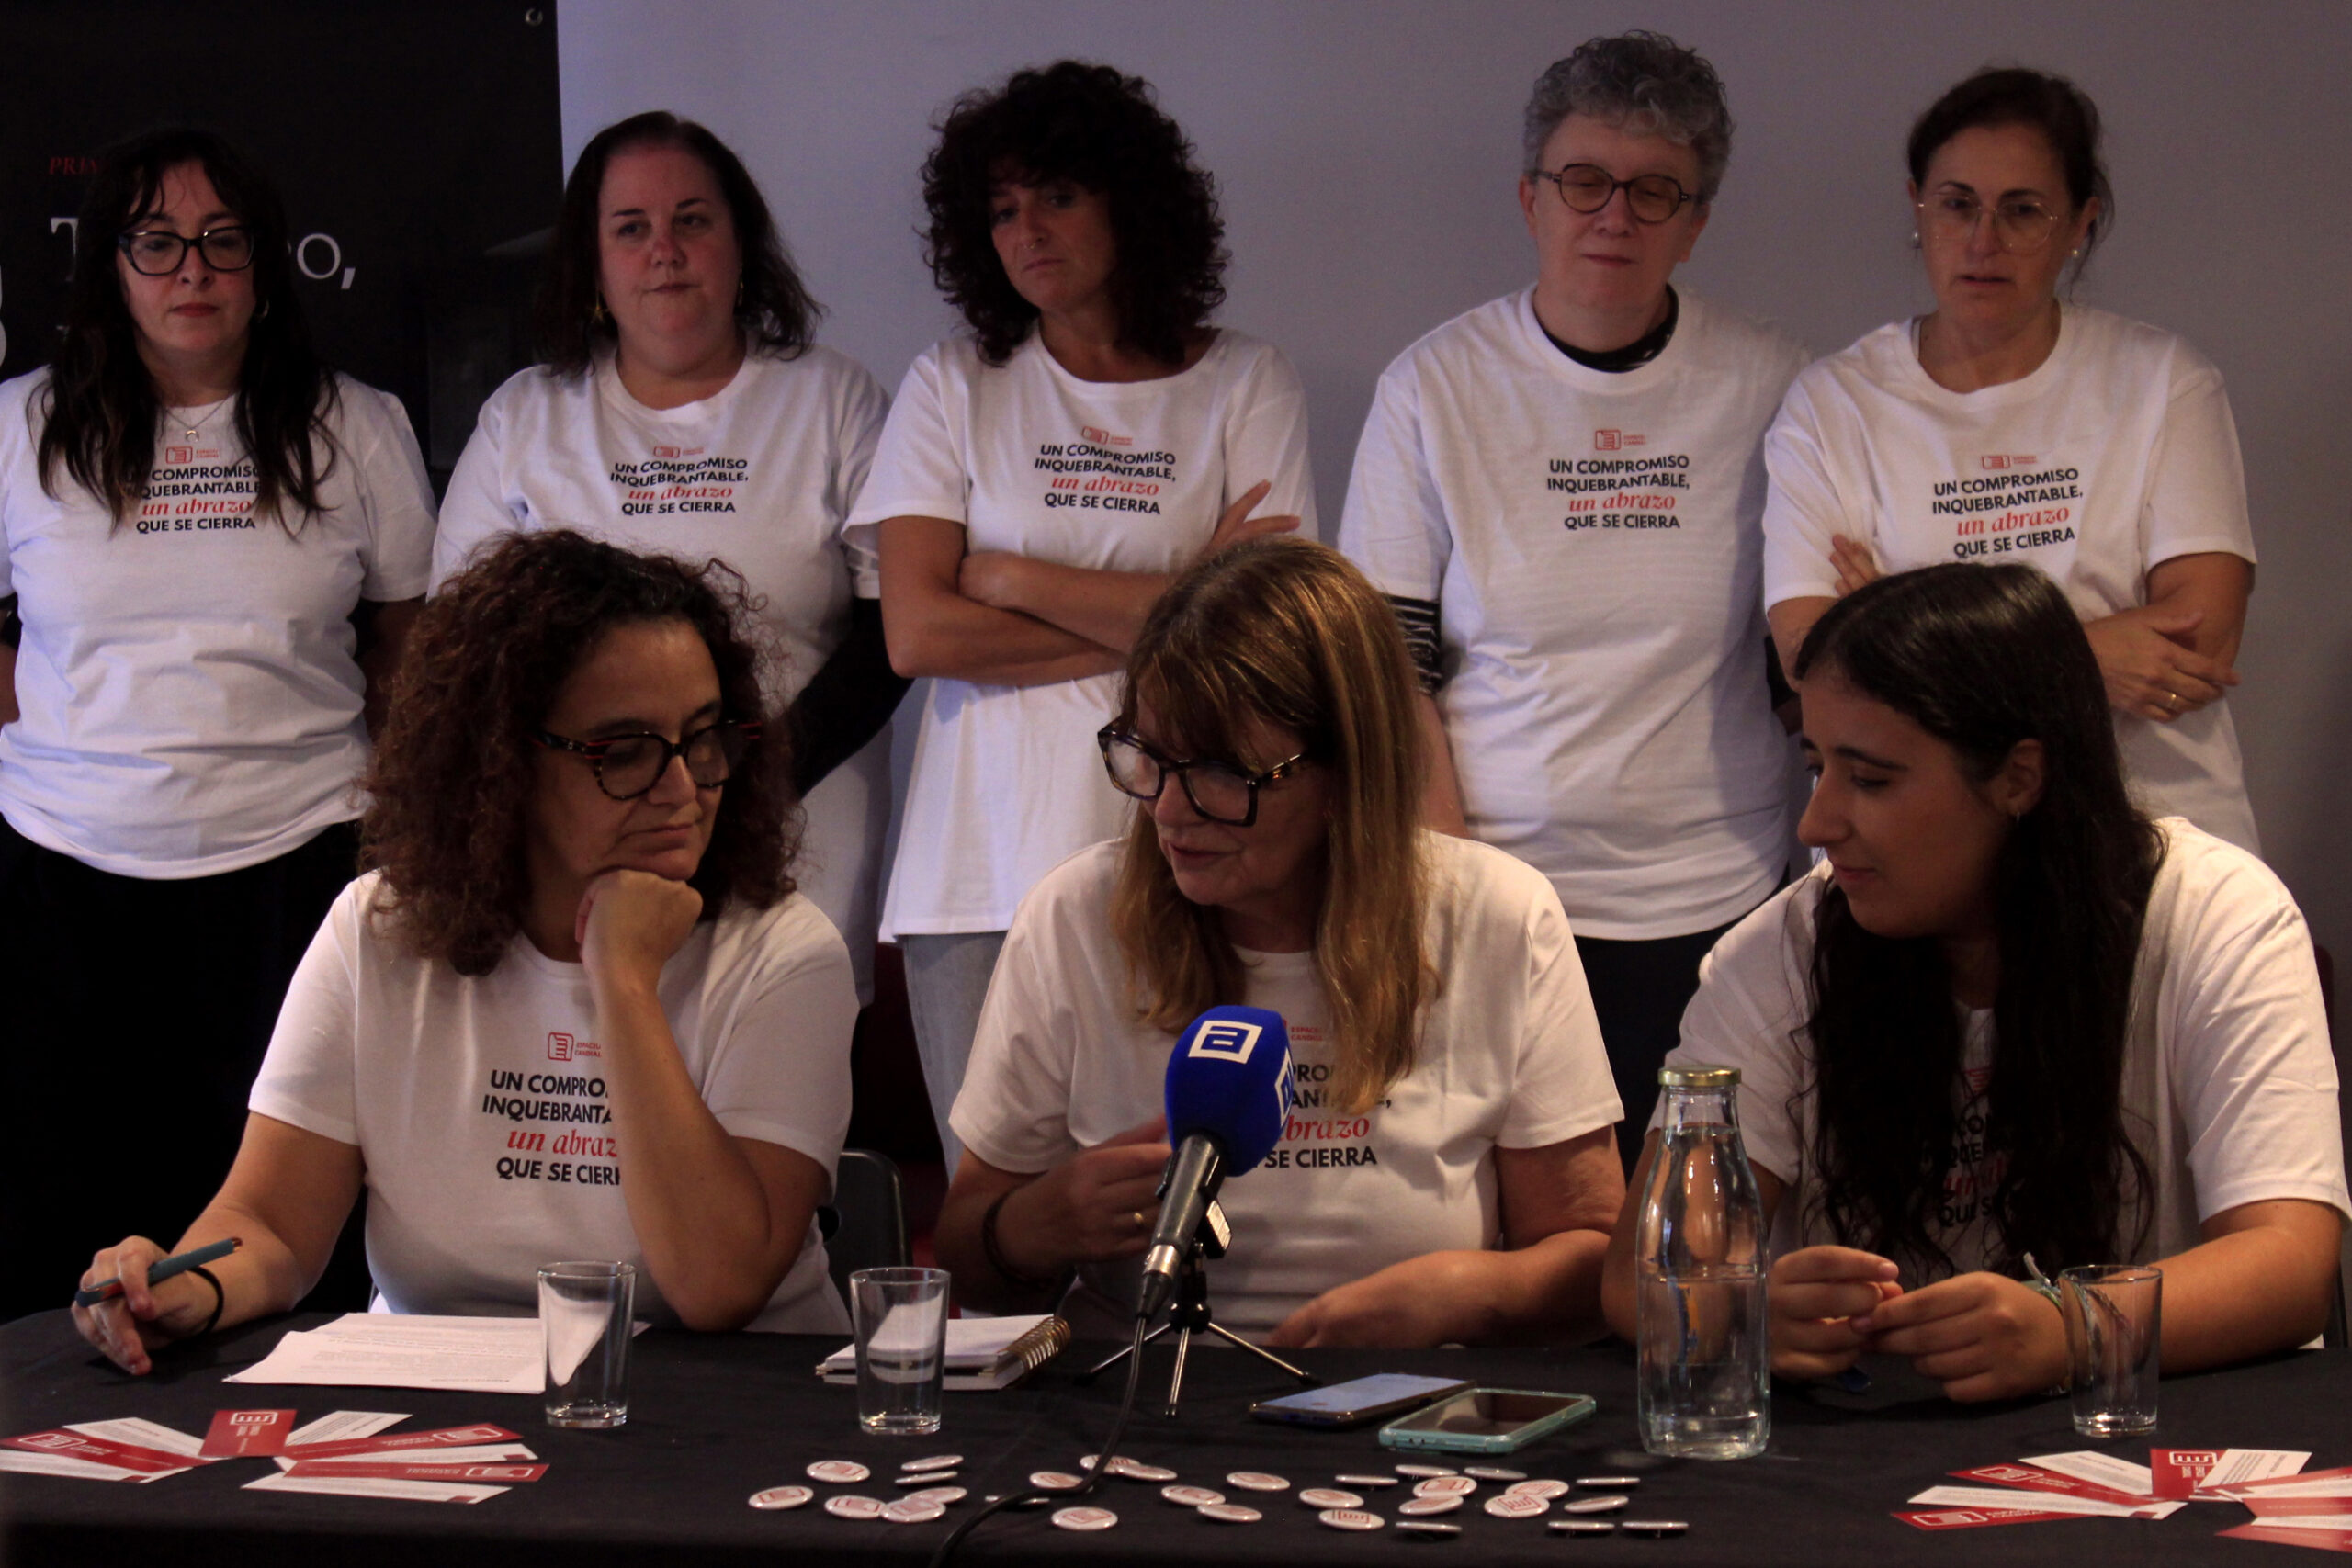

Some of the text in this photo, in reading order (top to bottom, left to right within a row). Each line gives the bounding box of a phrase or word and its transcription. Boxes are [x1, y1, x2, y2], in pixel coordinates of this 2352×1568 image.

[1040, 444, 1176, 465] UN COMPROMISO
[1549, 455, 1690, 474] UN COMPROMISO
[615, 457, 748, 474] UN COMPROMISO
[1034, 457, 1177, 482] INQUEBRANTABLE,
[610, 471, 749, 488] INQUEBRANTABLE,
[1051, 476, 1159, 496] un abrazo
[1547, 473, 1690, 493] INQUEBRANTABLE,
[1934, 468, 2079, 496] UN COMPROMISO
[628, 486, 733, 501] un abrazo
[1044, 492, 1160, 514] QUE SE CIERRA
[1569, 491, 1676, 512] un abrazo
[1932, 485, 2083, 515] INQUEBRANTABLE,
[141, 498, 252, 516] un abrazo
[621, 501, 736, 515] QUE SE CIERRA
[136, 517, 255, 534] QUE SE CIERRA
[1564, 514, 1680, 531] QUE SE CIERRA
[1957, 506, 2070, 536] un abrazo
[1953, 526, 2075, 558] QUE SE CIERRA
[490, 1069, 609, 1098] UN COMPRO
[1278, 1114, 1370, 1142] brazo
[506, 1128, 619, 1158] un abraz
[1264, 1145, 1378, 1168] SE CIERRA
[496, 1156, 543, 1180] QUE
[547, 1162, 572, 1183] SE
